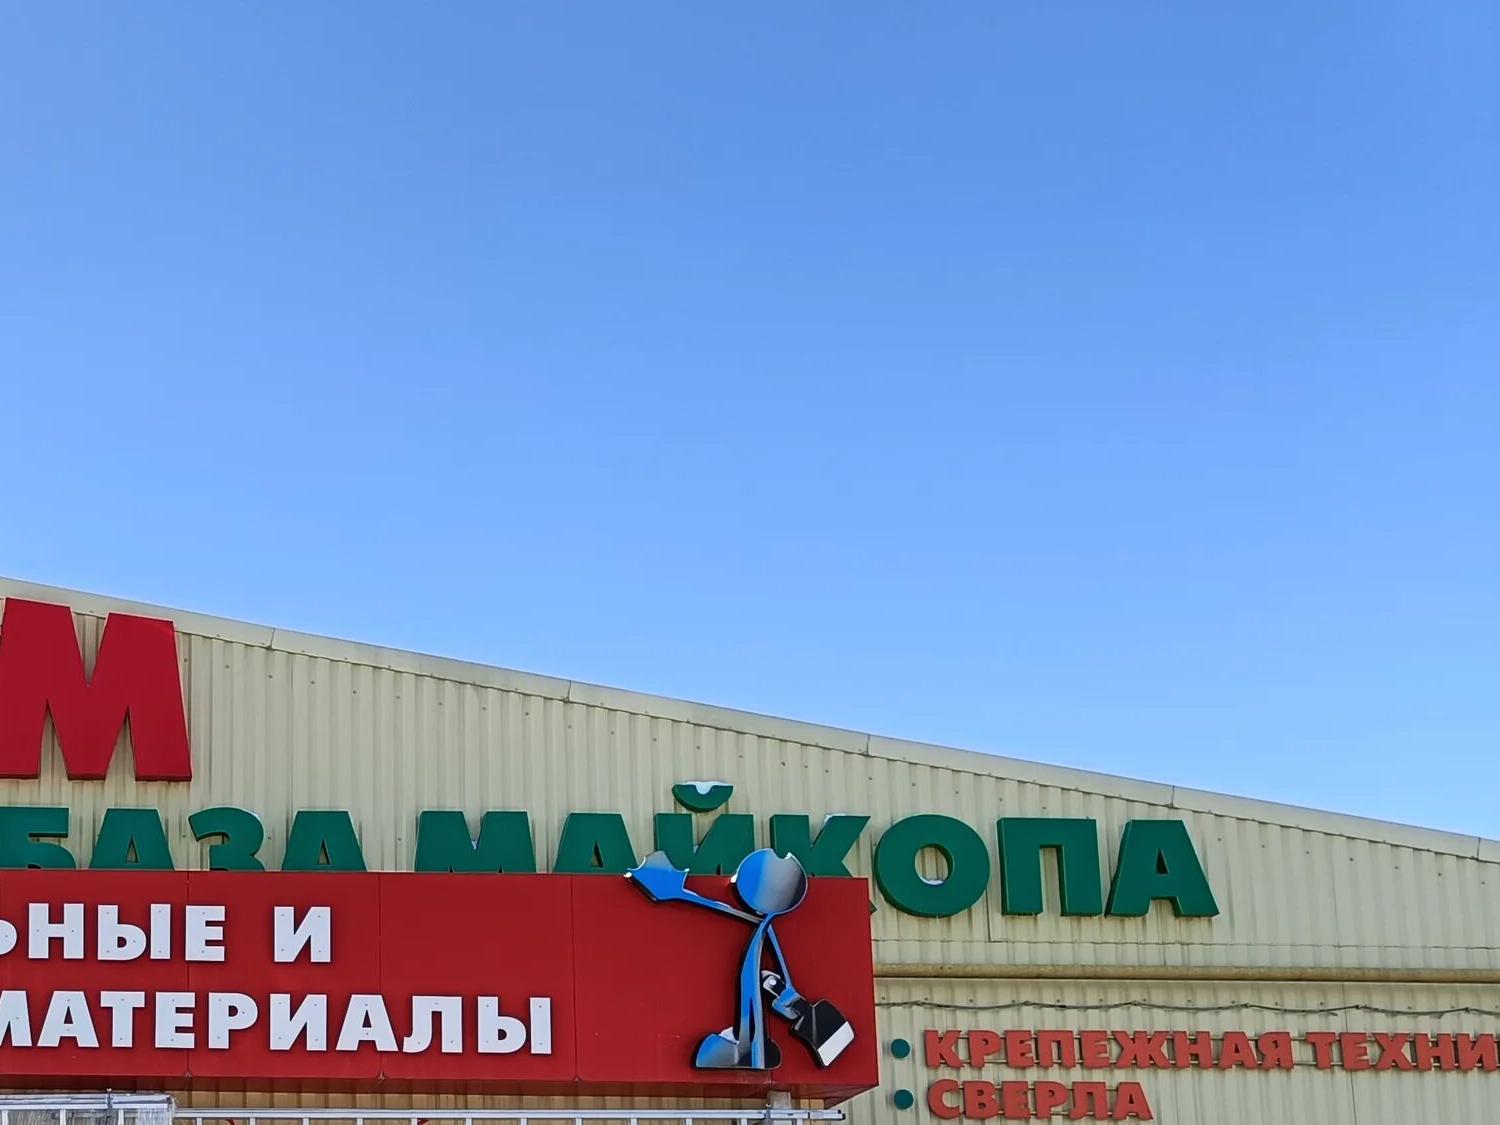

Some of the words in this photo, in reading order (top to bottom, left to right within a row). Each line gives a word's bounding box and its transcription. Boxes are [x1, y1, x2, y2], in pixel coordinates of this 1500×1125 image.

[414, 781, 1220, 918] МАЙКОПА
[274, 906, 332, 963] И
[924, 1029, 1296, 1070] КРЕПЕЖНАЯ
[1306, 1031, 1498, 1072] ТЕХНИ
[927, 1079, 1153, 1121] СВЕРЛА
